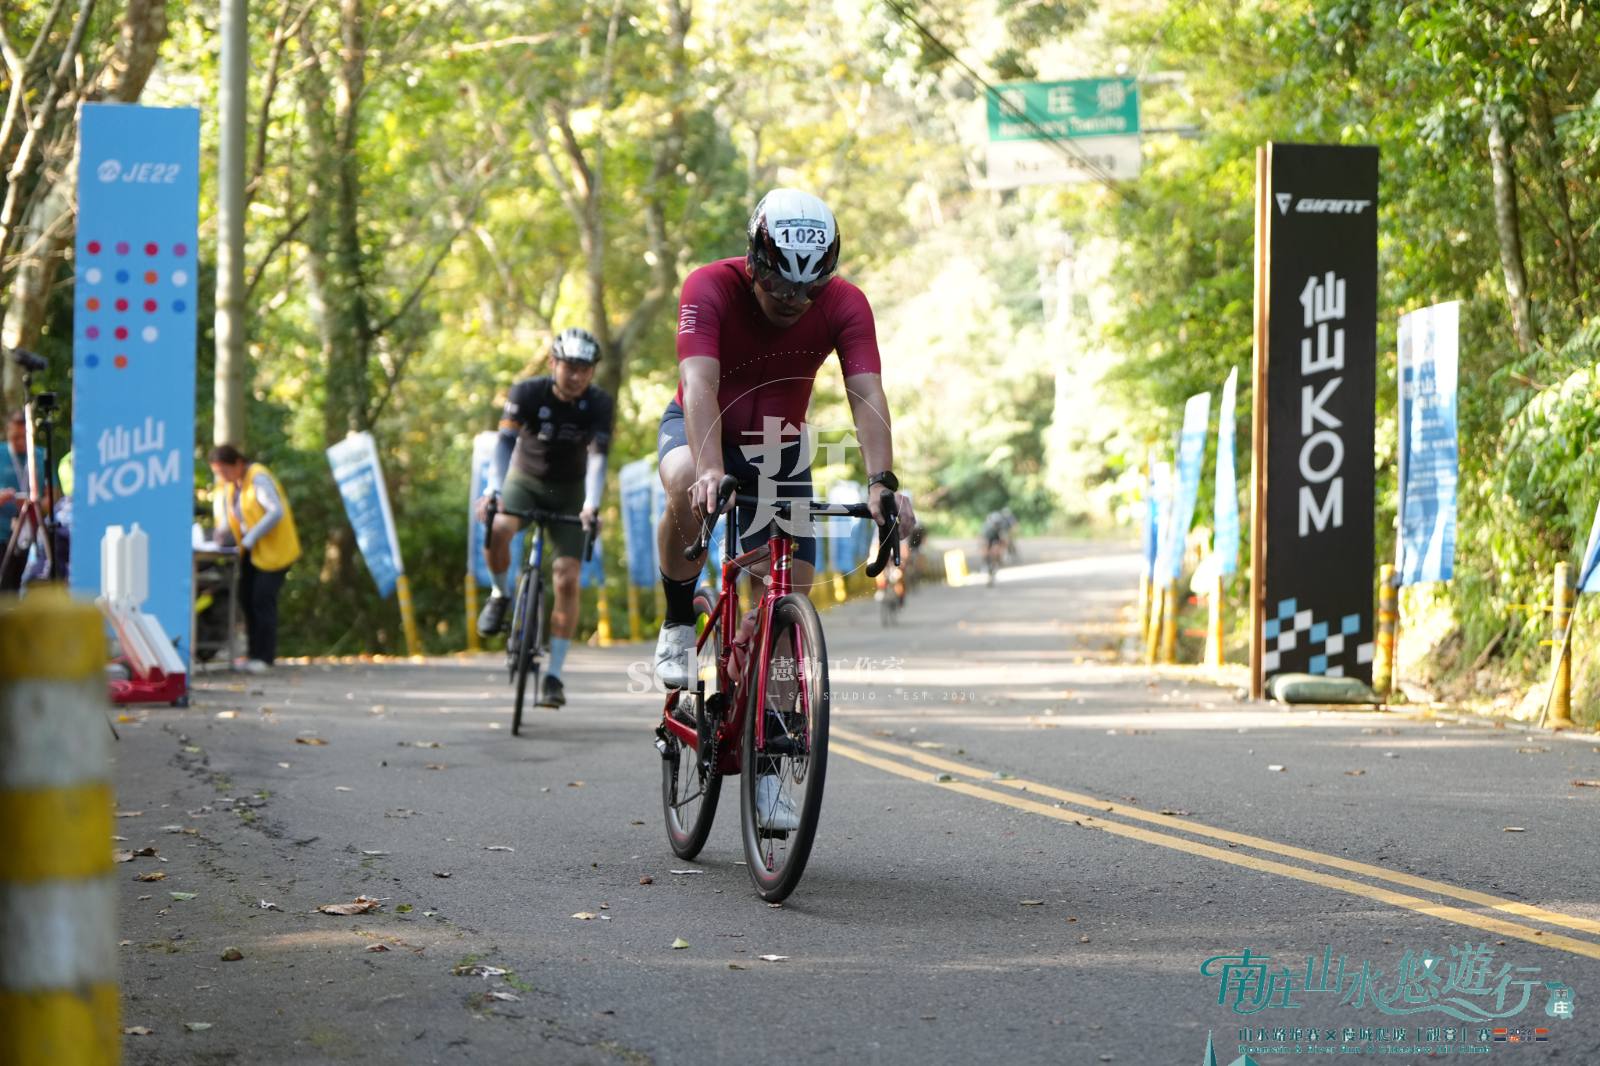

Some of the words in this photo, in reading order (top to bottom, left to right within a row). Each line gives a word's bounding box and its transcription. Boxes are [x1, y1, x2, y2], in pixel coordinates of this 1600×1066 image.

[121, 162, 180, 183] JE22
[781, 228, 826, 245] 1023
[97, 415, 165, 466] 仙山
[87, 448, 180, 507] KOM
